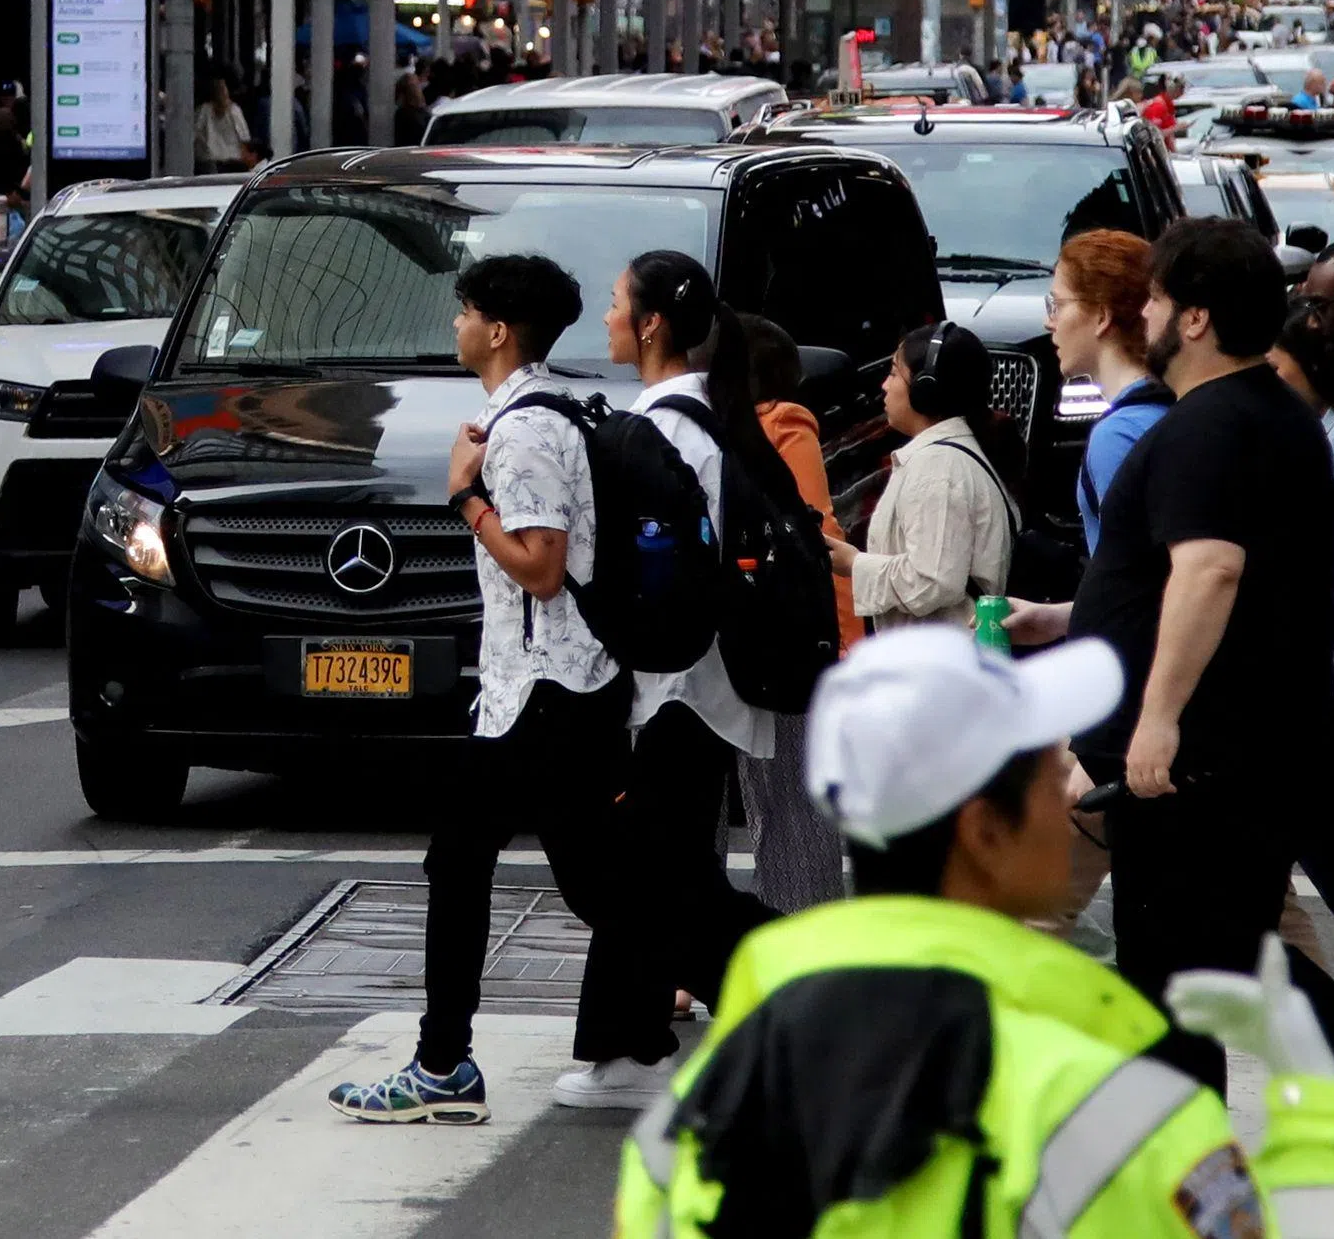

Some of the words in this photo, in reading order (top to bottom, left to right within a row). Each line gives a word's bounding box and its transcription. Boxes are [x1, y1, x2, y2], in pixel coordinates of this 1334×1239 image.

[331, 643, 356, 652] NEW
[361, 644, 386, 652] YORK
[313, 656, 402, 684] T732439C
